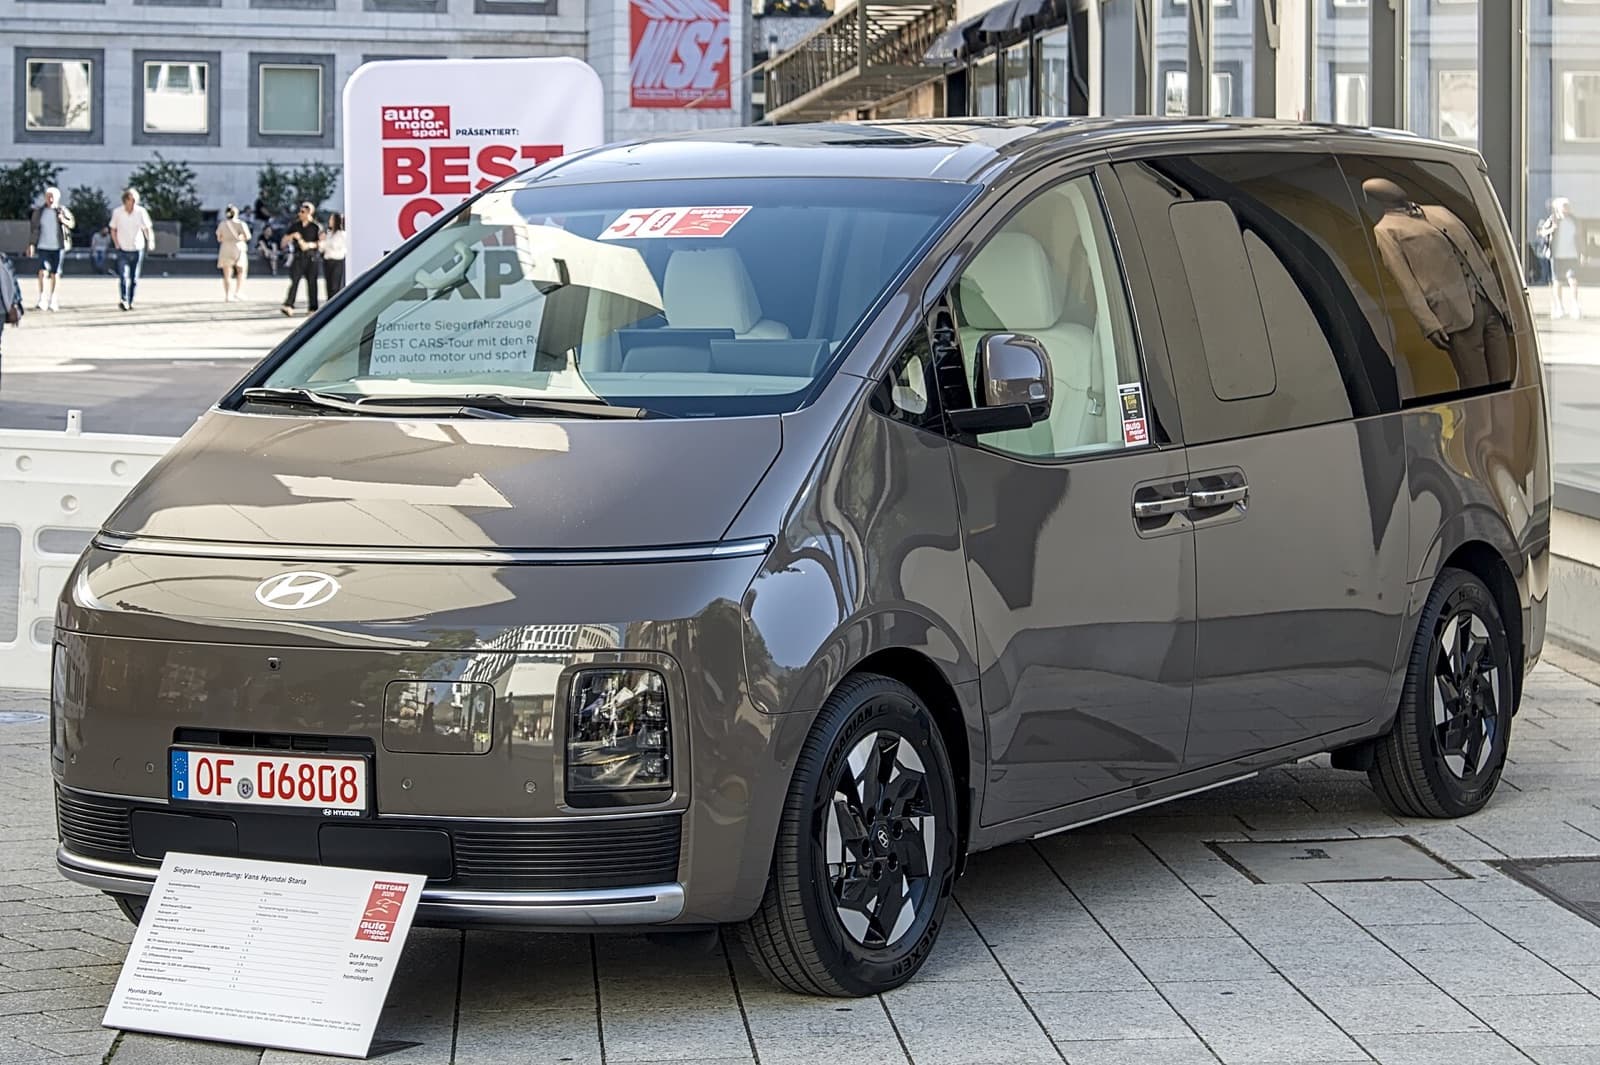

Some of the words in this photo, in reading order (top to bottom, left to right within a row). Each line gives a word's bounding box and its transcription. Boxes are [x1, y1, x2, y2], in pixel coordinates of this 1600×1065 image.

[384, 108, 434, 121] auto
[395, 120, 444, 129] motor
[412, 128, 448, 138] sport
[455, 128, 519, 136] PRÄSENTIERT:
[383, 144, 564, 195] BEST
[434, 319, 532, 332] Siegerfahrzeuge
[375, 338, 405, 350] BEST
[409, 336, 474, 349] CARS-Tour
[477, 335, 496, 347] mit
[500, 335, 523, 346] den
[375, 354, 396, 363] von
[400, 352, 425, 363] auto
[430, 351, 466, 362] motor
[469, 350, 492, 361] und
[495, 350, 527, 362] sport
[177, 780, 184, 792] D
[196, 757, 234, 796] OF
[258, 761, 358, 804] 06808
[173, 866, 194, 875] Sieger
[195, 868, 242, 880] Importwertung:
[244, 872, 259, 880] Vans
[260, 875, 286, 883] Hyundai
[287, 877, 307, 885] Staria
[360, 922, 386, 930] auto
[891, 919, 938, 977] NEXEN
[360, 953, 383, 962] Fahrzeug
[128, 987, 147, 995] Hyundai
